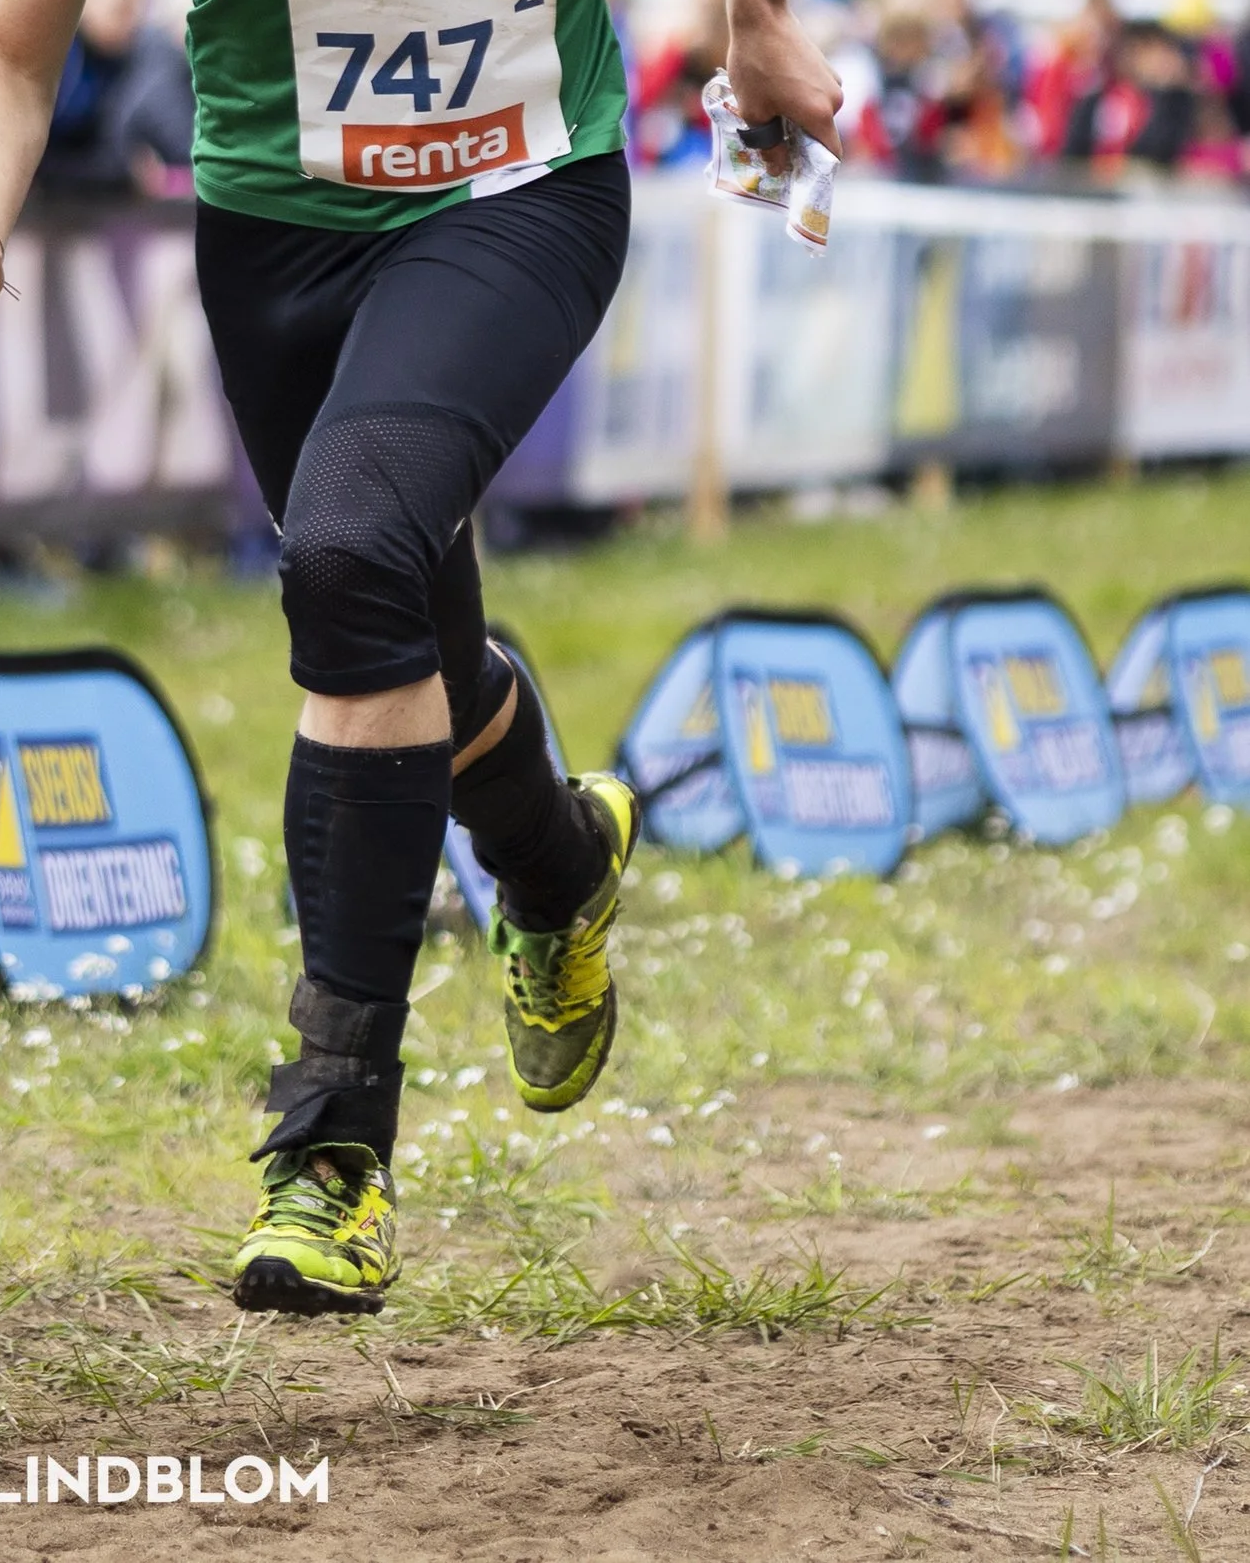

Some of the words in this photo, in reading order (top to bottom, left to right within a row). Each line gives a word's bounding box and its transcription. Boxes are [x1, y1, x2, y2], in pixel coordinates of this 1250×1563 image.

[316, 19, 494, 113] 747
[361, 126, 509, 178] renta
[19, 744, 113, 825] SVENSK
[41, 840, 187, 931] ORIENTERING
